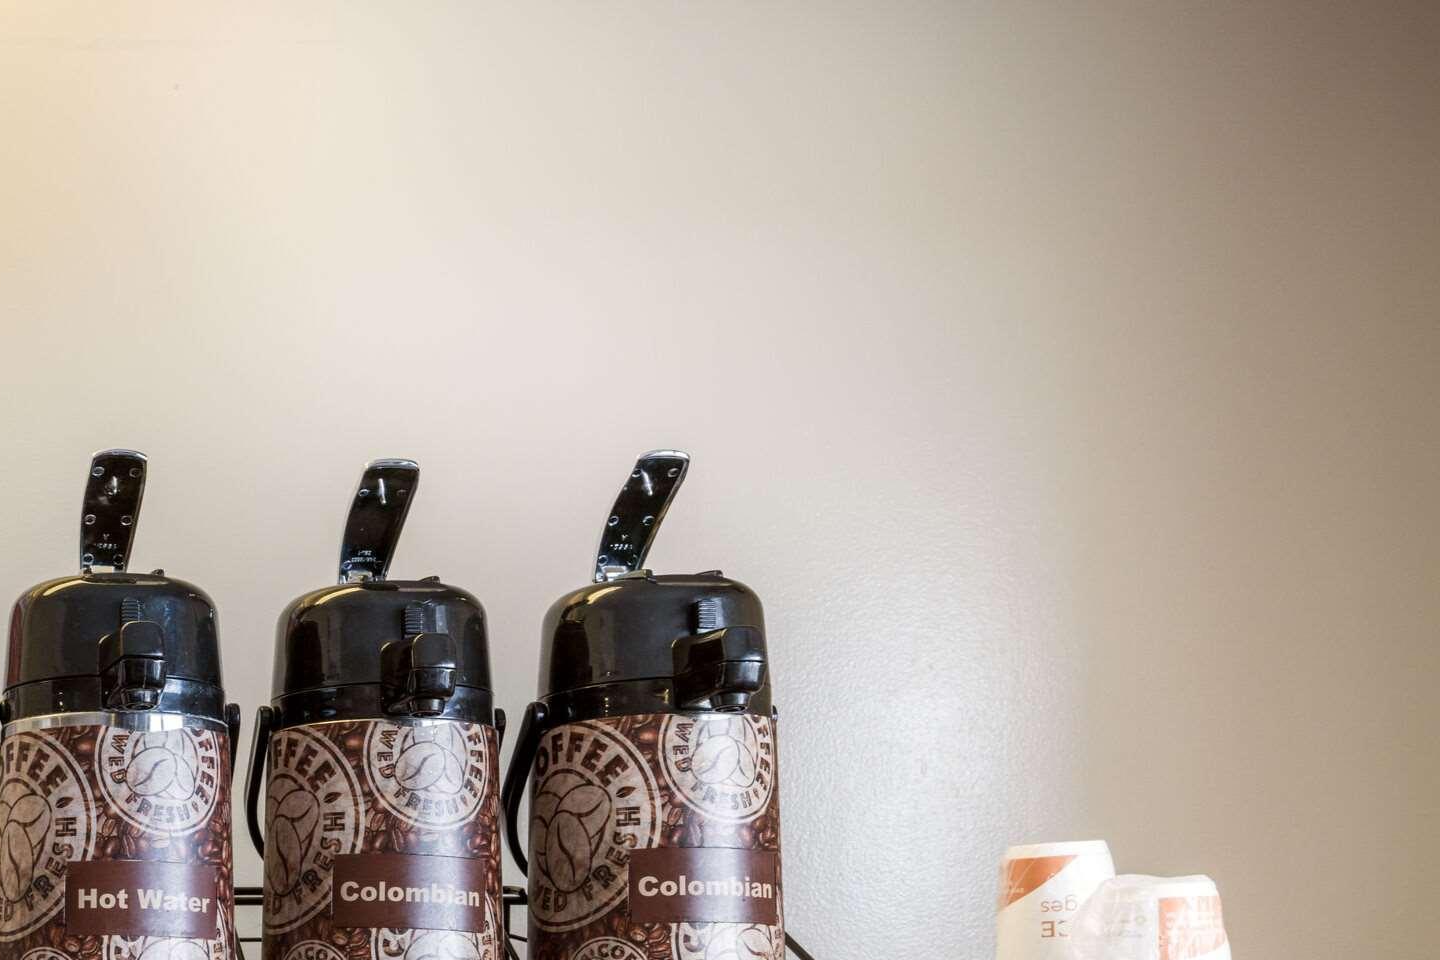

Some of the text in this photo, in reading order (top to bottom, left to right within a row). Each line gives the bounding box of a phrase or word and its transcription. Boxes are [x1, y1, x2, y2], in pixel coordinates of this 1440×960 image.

[581, 806, 641, 902] FRESH
[77, 887, 211, 914] Hot Water
[339, 880, 481, 908] Colombian
[637, 875, 773, 901] Colombian
